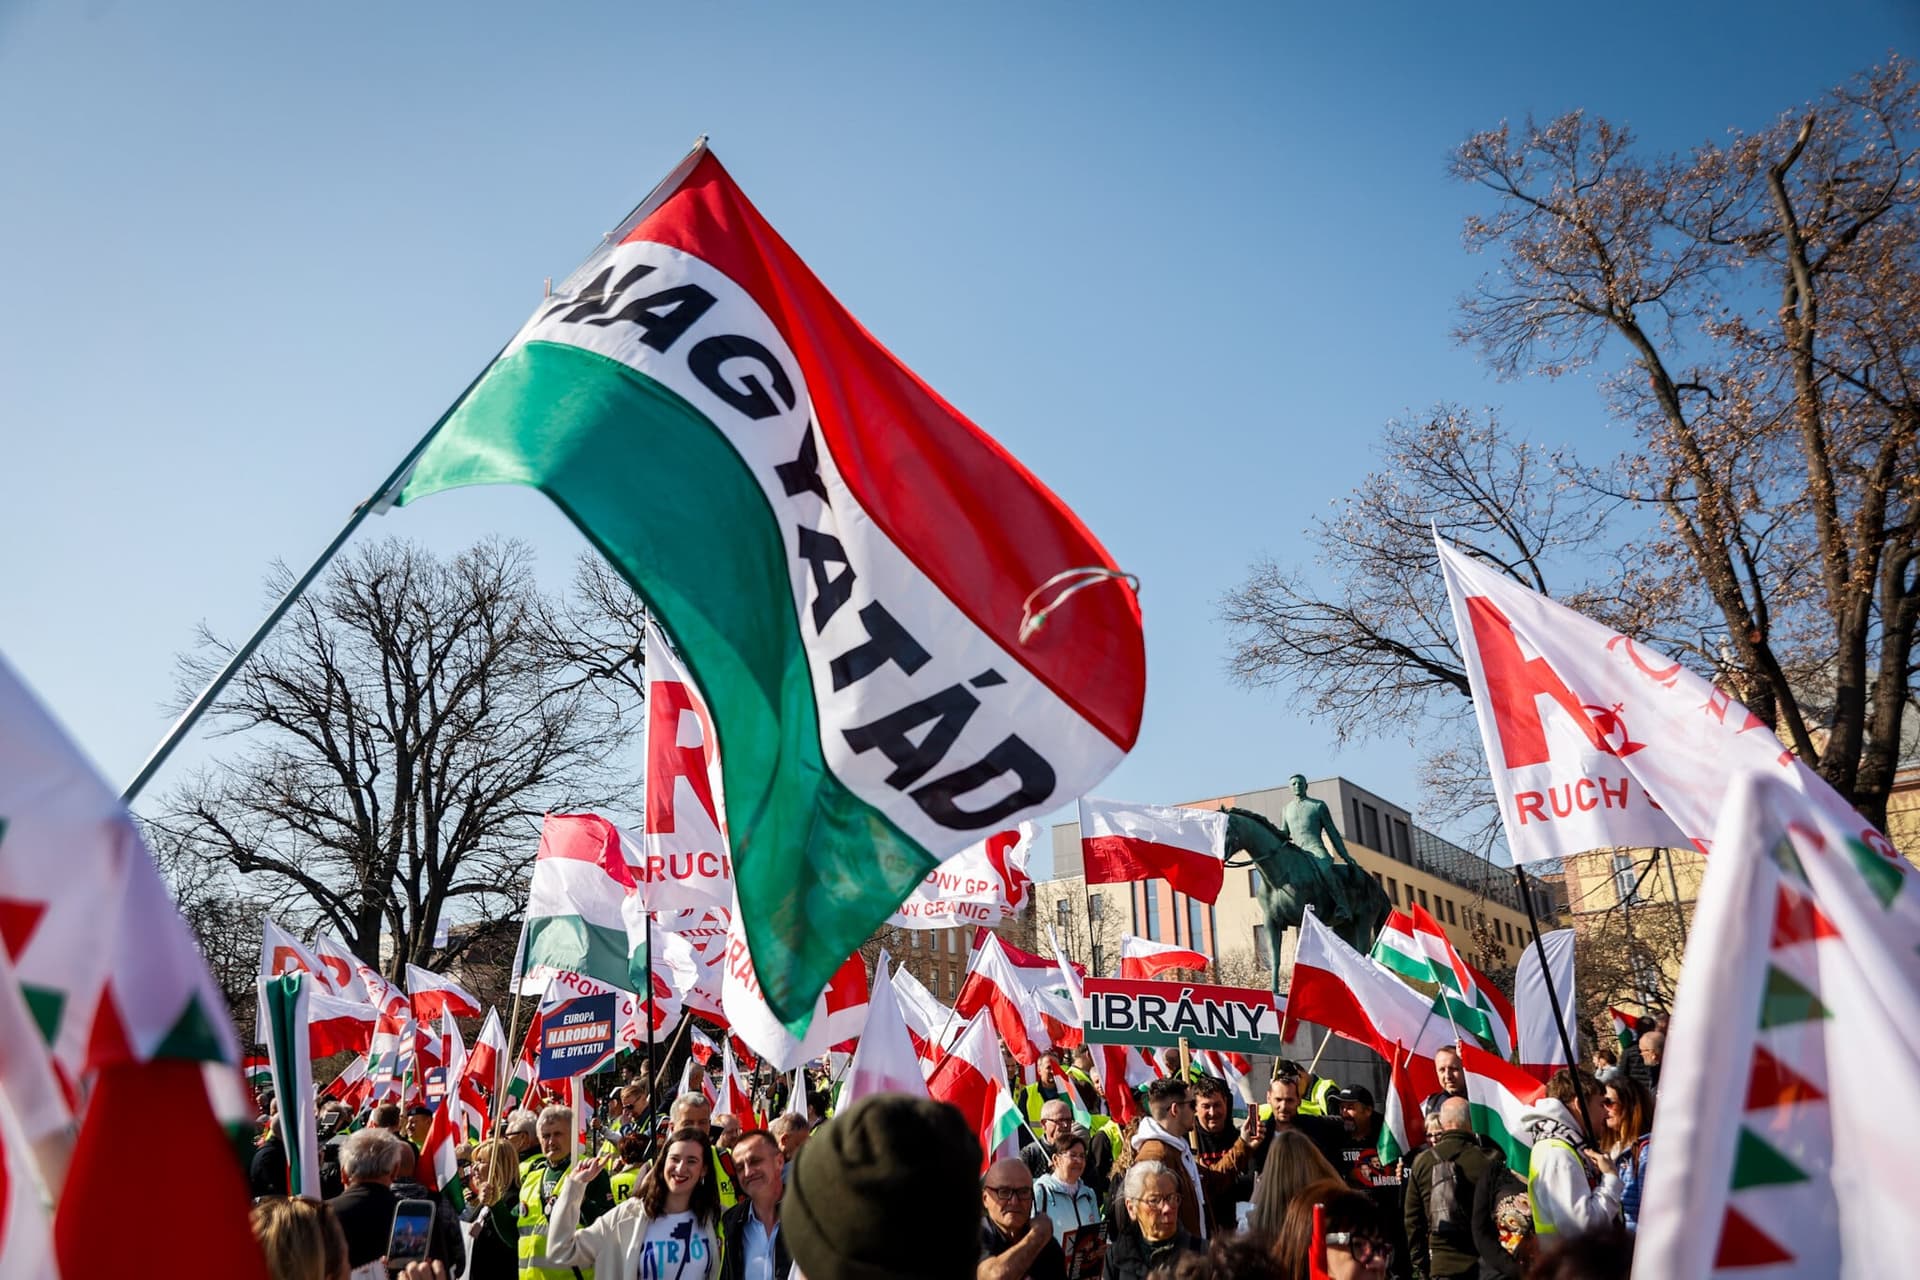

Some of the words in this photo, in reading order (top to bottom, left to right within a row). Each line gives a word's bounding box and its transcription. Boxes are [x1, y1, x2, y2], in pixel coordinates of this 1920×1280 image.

[538, 264, 1057, 831] NAGYATÁD
[1515, 776, 1629, 825] RUCH
[924, 901, 991, 921] GRANIC
[563, 1011, 595, 1025] EUROPA
[1090, 989, 1267, 1040] IBRÁNY
[547, 1023, 609, 1045] NARODÓW
[551, 1046, 566, 1060] NIE
[567, 1042, 604, 1058] DYKTATU
[1343, 1151, 1360, 1161] STOP
